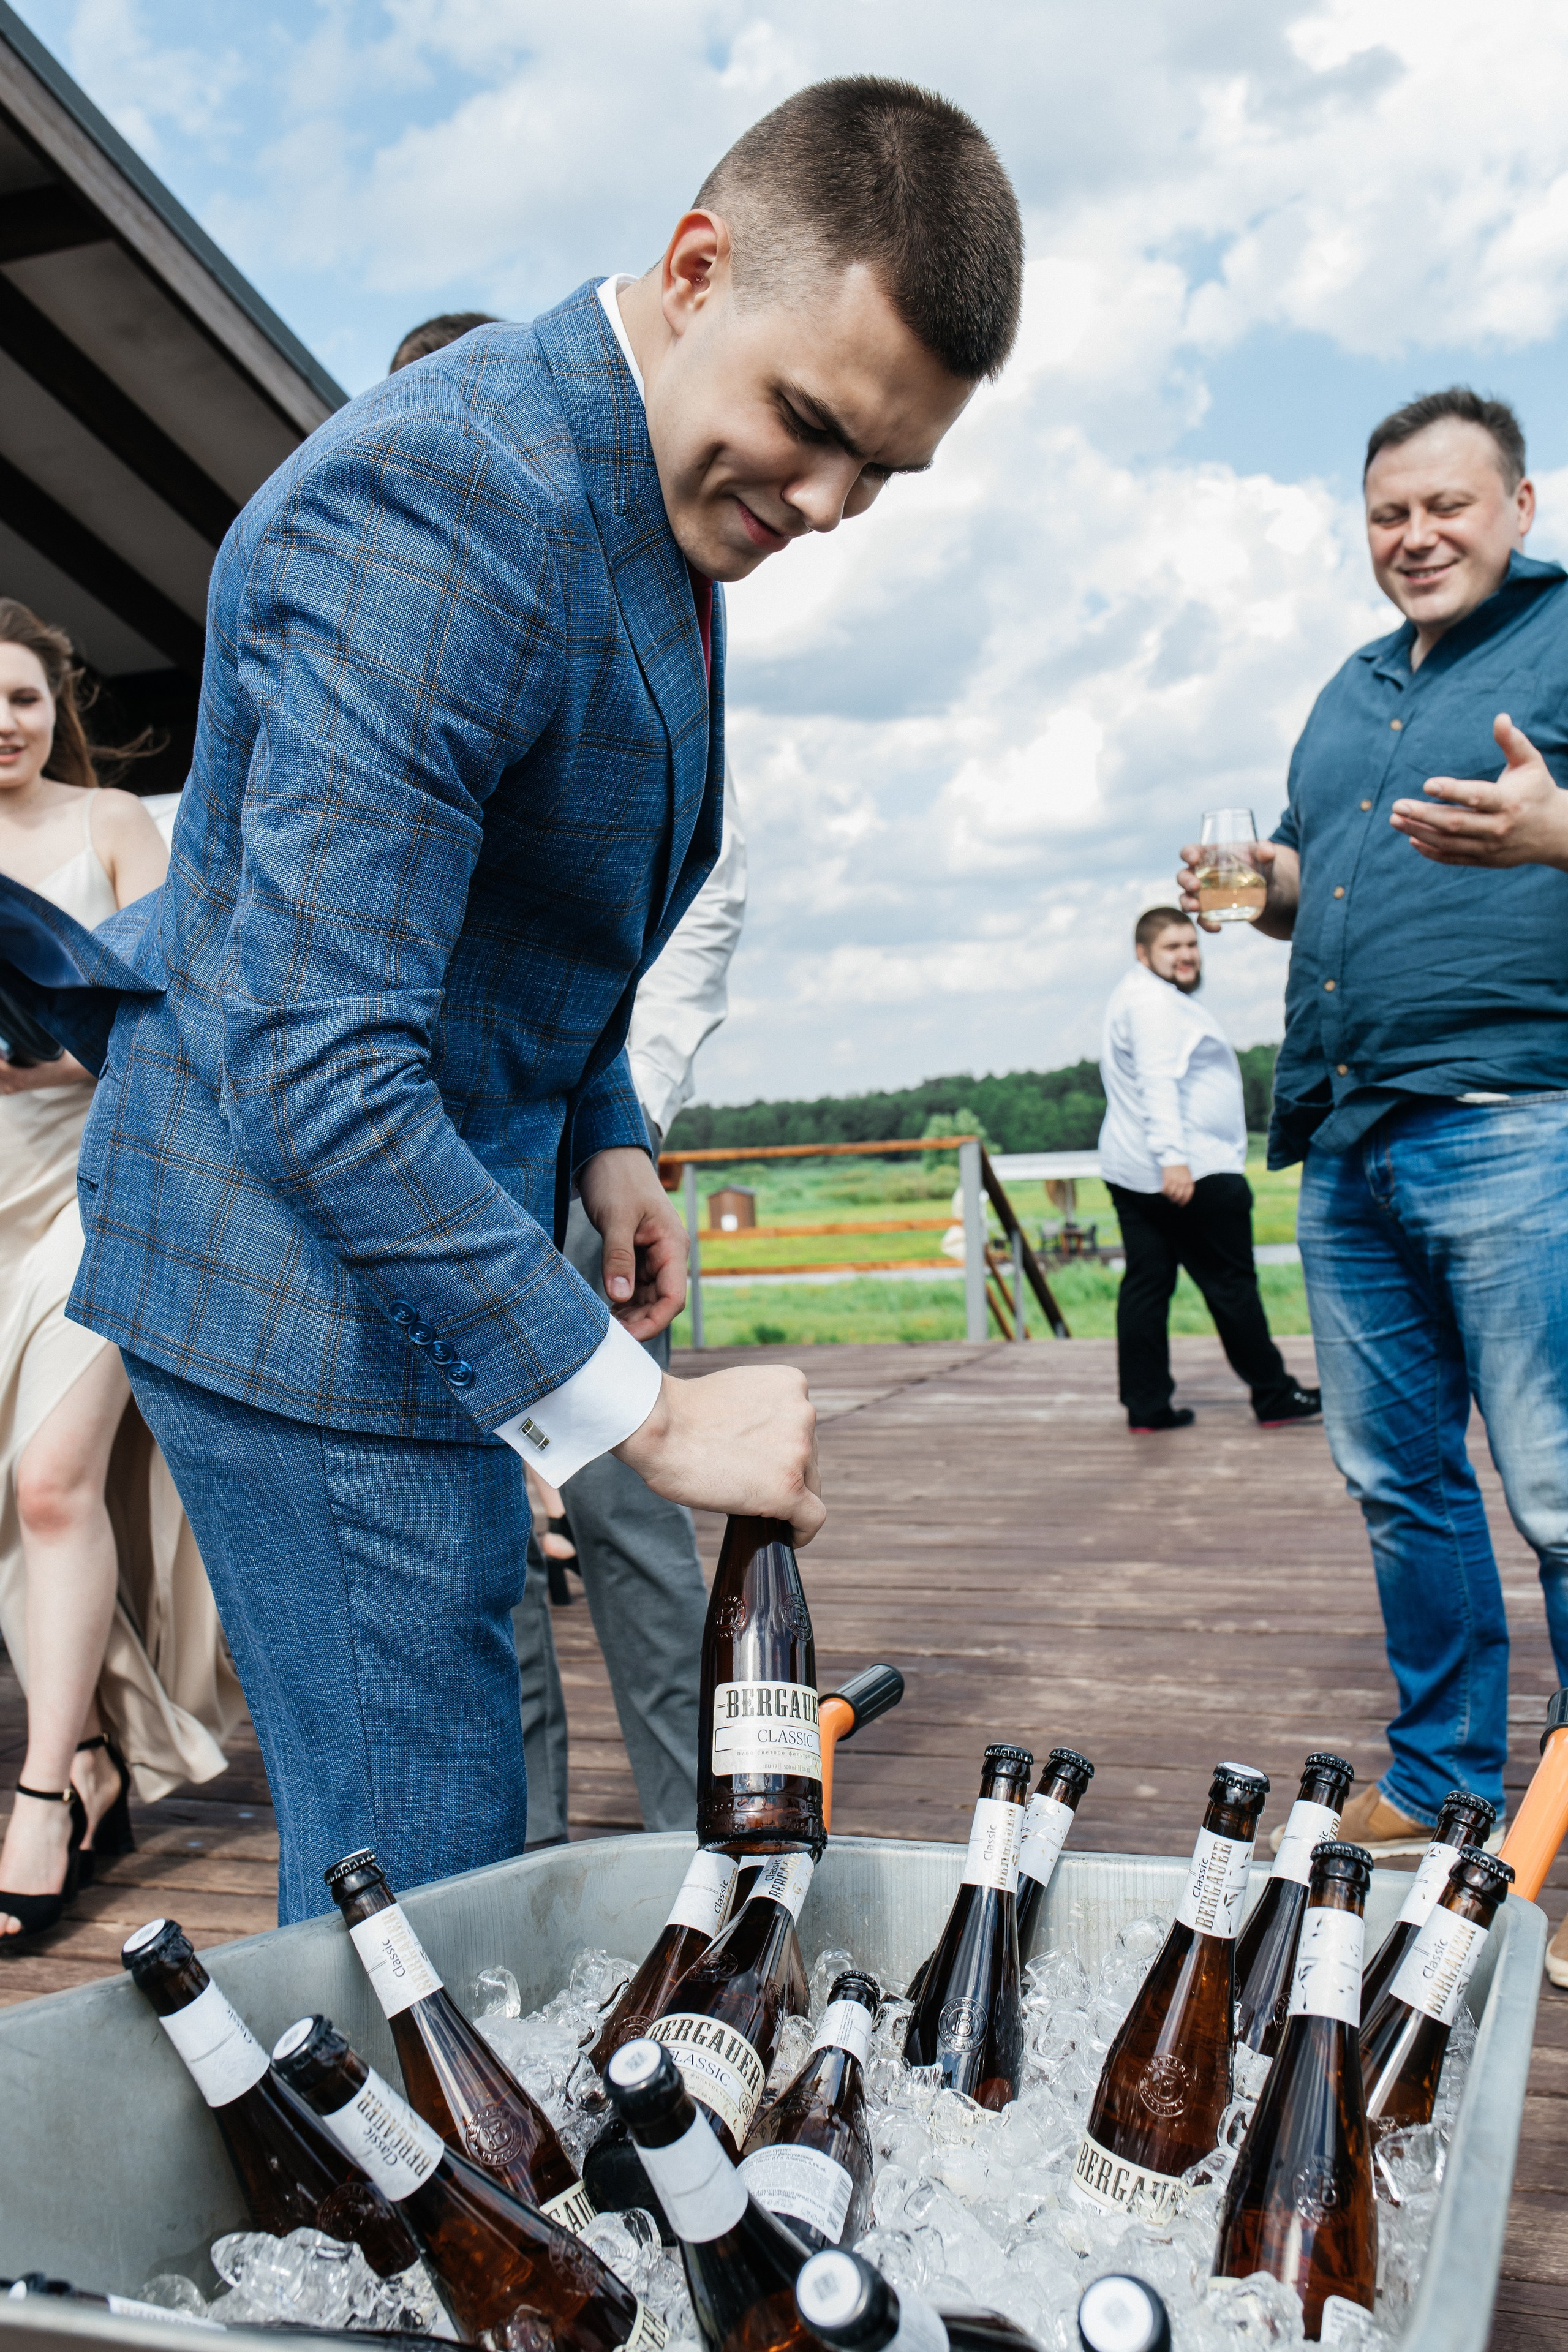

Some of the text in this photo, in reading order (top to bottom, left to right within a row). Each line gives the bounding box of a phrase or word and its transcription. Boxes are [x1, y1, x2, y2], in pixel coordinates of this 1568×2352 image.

[726, 1688, 820, 1727] BERGAUE
[758, 1729, 813, 1748] CLASSIC
[983, 1825, 997, 1861] Classic
[765, 1858, 782, 1882] Classic
[1193, 1858, 1209, 1898] Classic
[1194, 1841, 1232, 1931] BERGAUER
[714, 1879, 729, 1914] Classic
[382, 1939, 405, 1978] Classic
[1422, 1938, 1449, 1979] Classic
[649, 2019, 762, 2095] BERGAUER
[357, 2090, 432, 2178] BERGAUER
[363, 2127, 398, 2166] Classic
